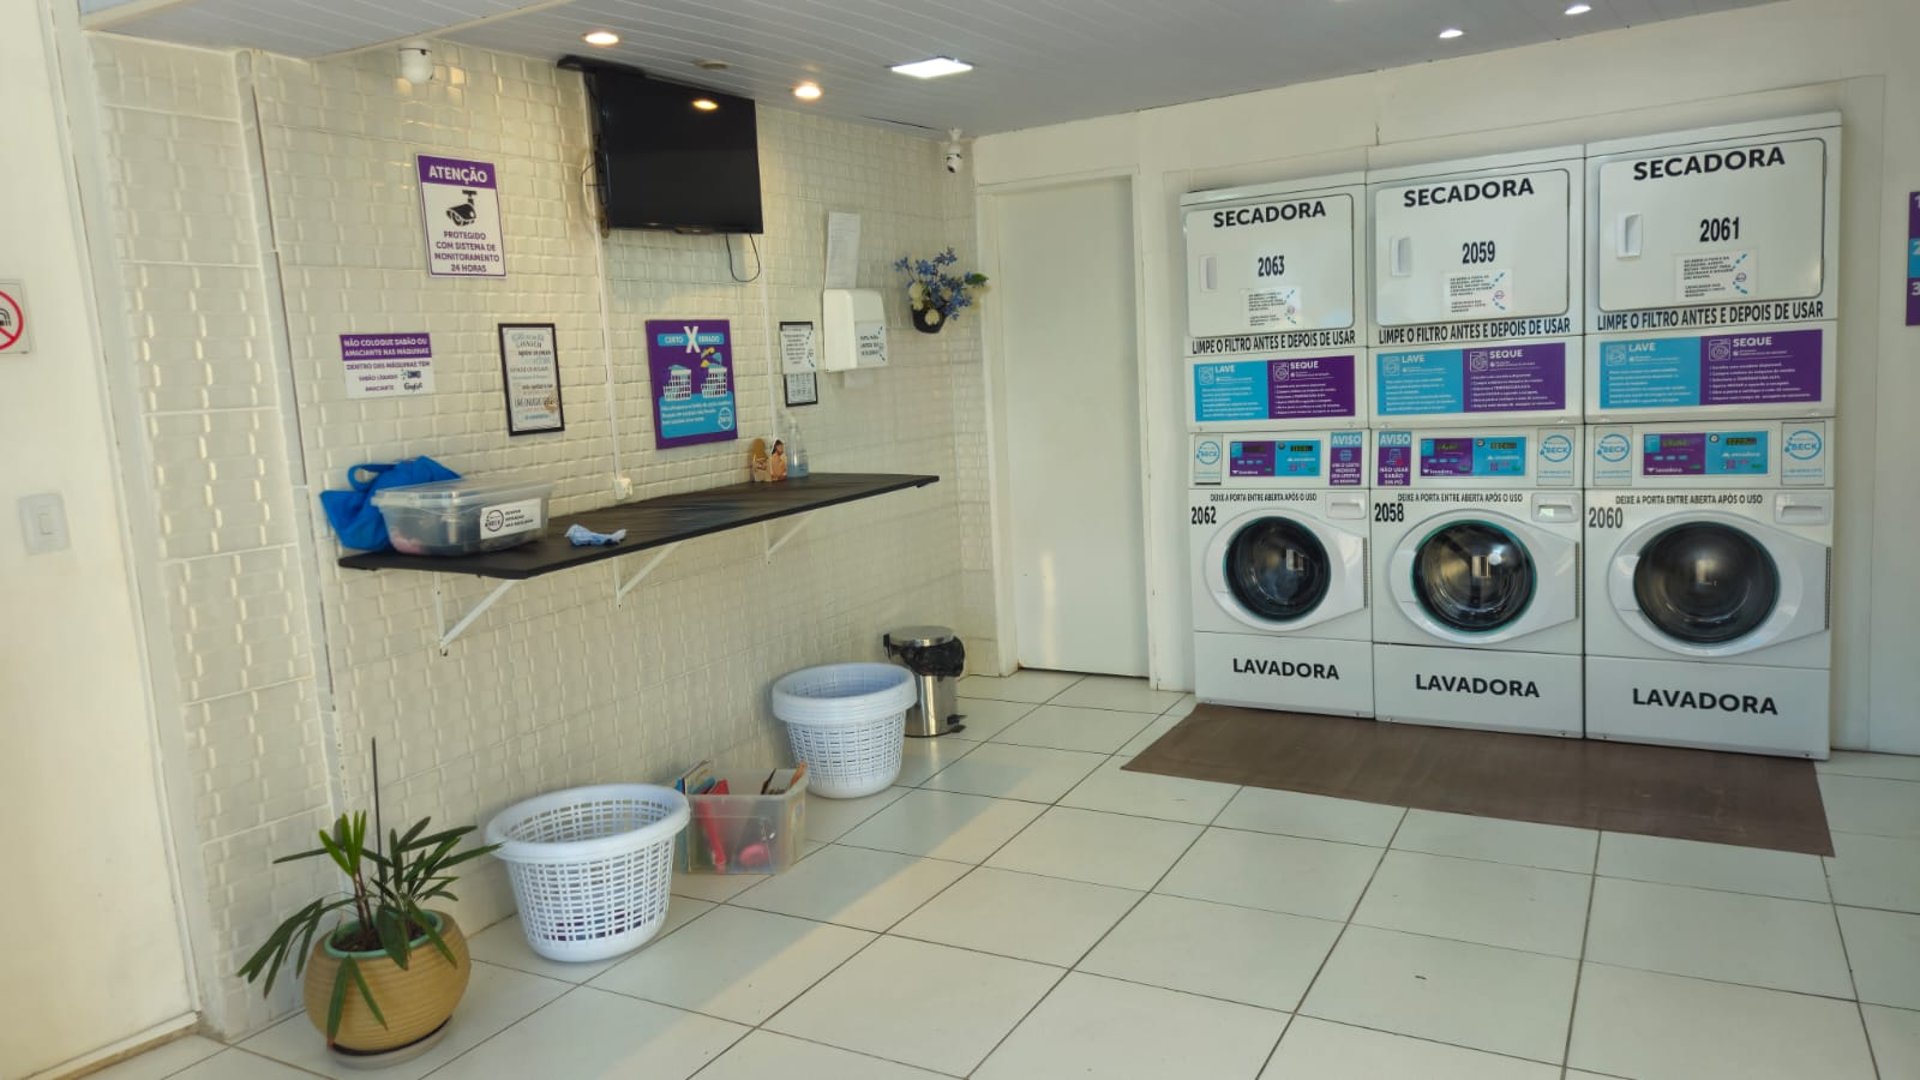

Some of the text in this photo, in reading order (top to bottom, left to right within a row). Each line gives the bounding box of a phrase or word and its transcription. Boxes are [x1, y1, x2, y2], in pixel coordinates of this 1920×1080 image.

[1633, 147, 1785, 181] SECADORA
[429, 165, 488, 184] ATENÇÃO
[1403, 178, 1534, 208] SECADORA
[1213, 200, 1326, 228] SECADORA
[443, 231, 486, 240] PROTEGIDO
[1700, 216, 1740, 242] 2061
[435, 241, 496, 251] COM SISTEMA DE
[1462, 241, 1495, 264] 2059
[434, 253, 499, 262] MONITORAMENTO
[1258, 255, 1285, 277] 2063
[1597, 300, 1824, 331] LIMPE O FILTRO ANTES E DEPOIS DE USAR
[683, 325, 700, 353] X
[1379, 317, 1570, 344] LIMPE O FILTRO ANTES E DEPOIS DE USAR
[344, 338, 360, 346] NÃO
[361, 338, 393, 346] COLOQUE
[1192, 329, 1355, 354] LIMPE O FILTRO ANTES E DEPOIS DE USAR
[1628, 343, 1655, 352] LAVE
[1733, 336, 1772, 347] SEQUE
[1402, 354, 1425, 363] LAVE
[1489, 349, 1523, 359] SEQUE
[1215, 365, 1235, 373] LAVE
[1290, 360, 1319, 369] SEQUE
[1332, 435, 1360, 445] AVISO
[1380, 434, 1411, 445] AVISO
[1210, 493, 1225, 501] DEIXE
[1225, 493, 1230, 501] A
[1230, 493, 1246, 501] PORTA
[1247, 493, 1264, 501] ENTRE
[1264, 493, 1284, 501] ABERTA
[1285, 492, 1299, 500] APÓS
[1398, 493, 1414, 502] DEIXE
[1421, 493, 1440, 501] PORTA
[1441, 494, 1460, 502] ENTRE
[1461, 494, 1484, 502] ABERTA
[1485, 492, 1501, 502] APÓS
[1503, 494, 1508, 502] O
[1510, 494, 1523, 502] USO
[1615, 492, 1763, 504] DEIXE A PORTA ENTRE ABERTA APÓS O USO
[1191, 506, 1217, 524] 2062
[1375, 503, 1404, 522] 2058
[1588, 507, 1623, 529] 2060
[1233, 658, 1340, 680] LAVADORA
[1415, 673, 1540, 698] LAVADORA
[1632, 688, 1778, 715] LAVADORA
